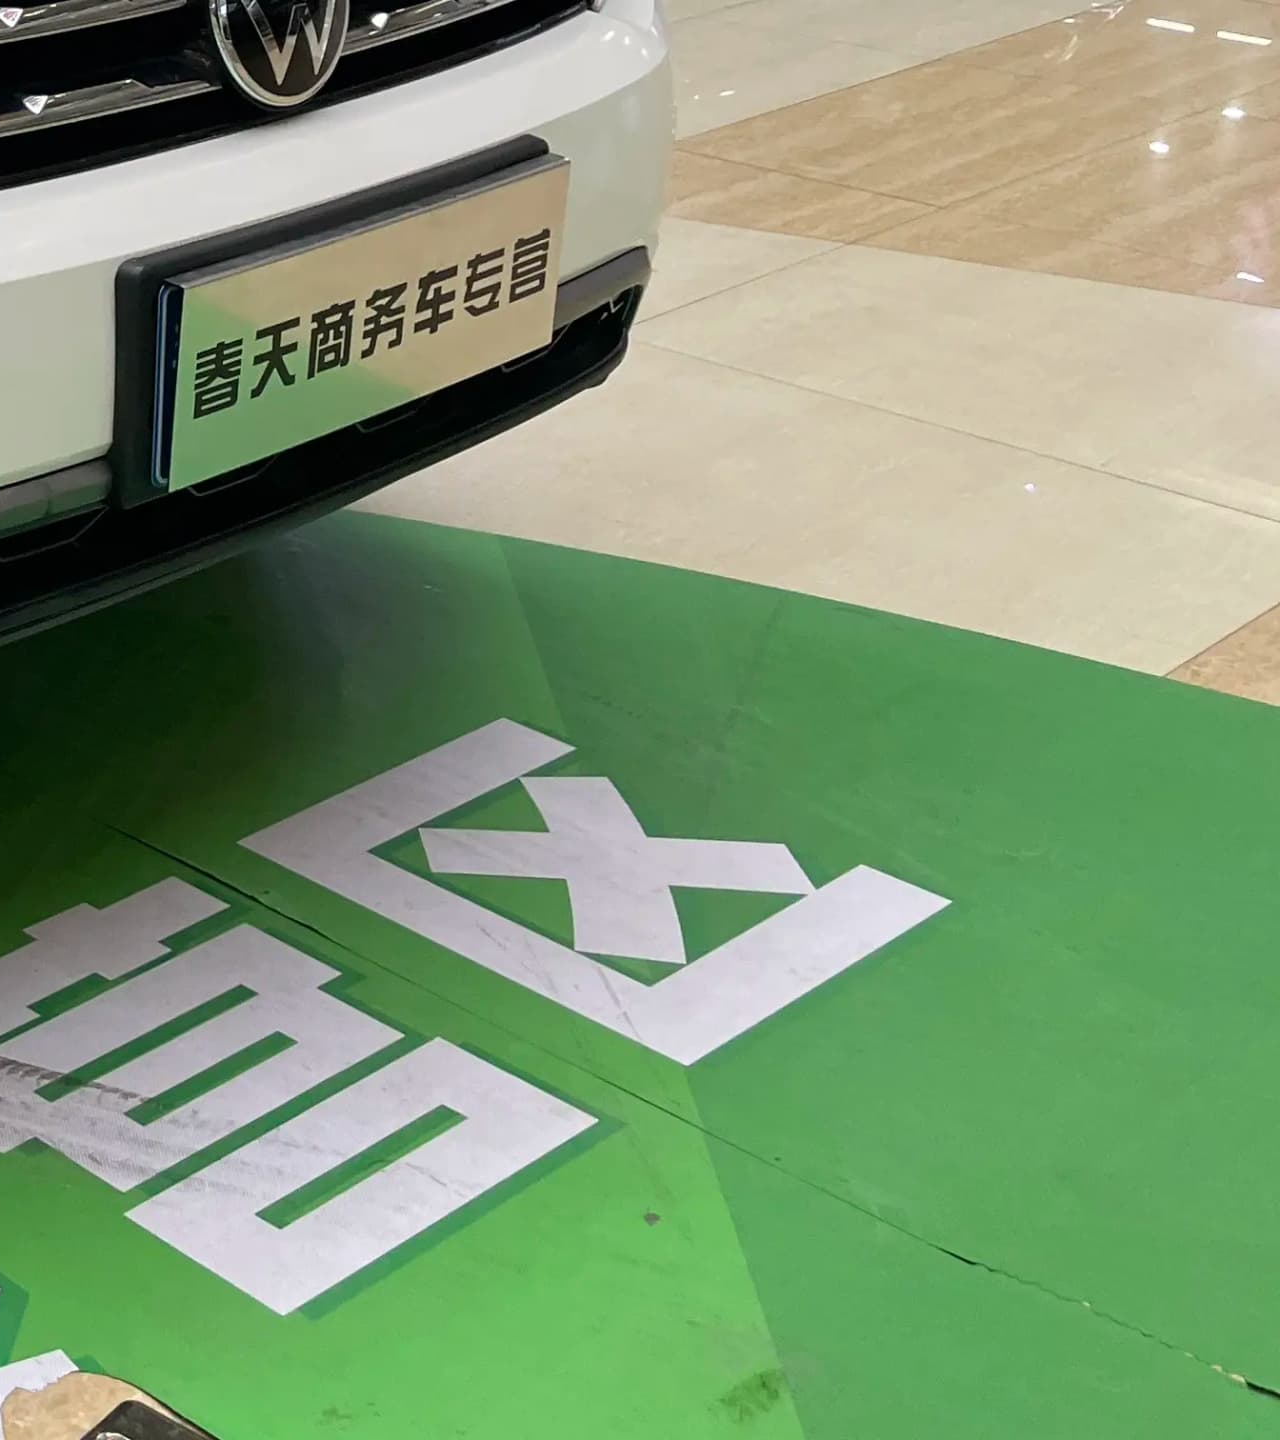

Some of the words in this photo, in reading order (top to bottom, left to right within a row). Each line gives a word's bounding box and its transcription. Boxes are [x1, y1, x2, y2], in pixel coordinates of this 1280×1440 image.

[192, 227, 552, 420] 春天商务车专营
